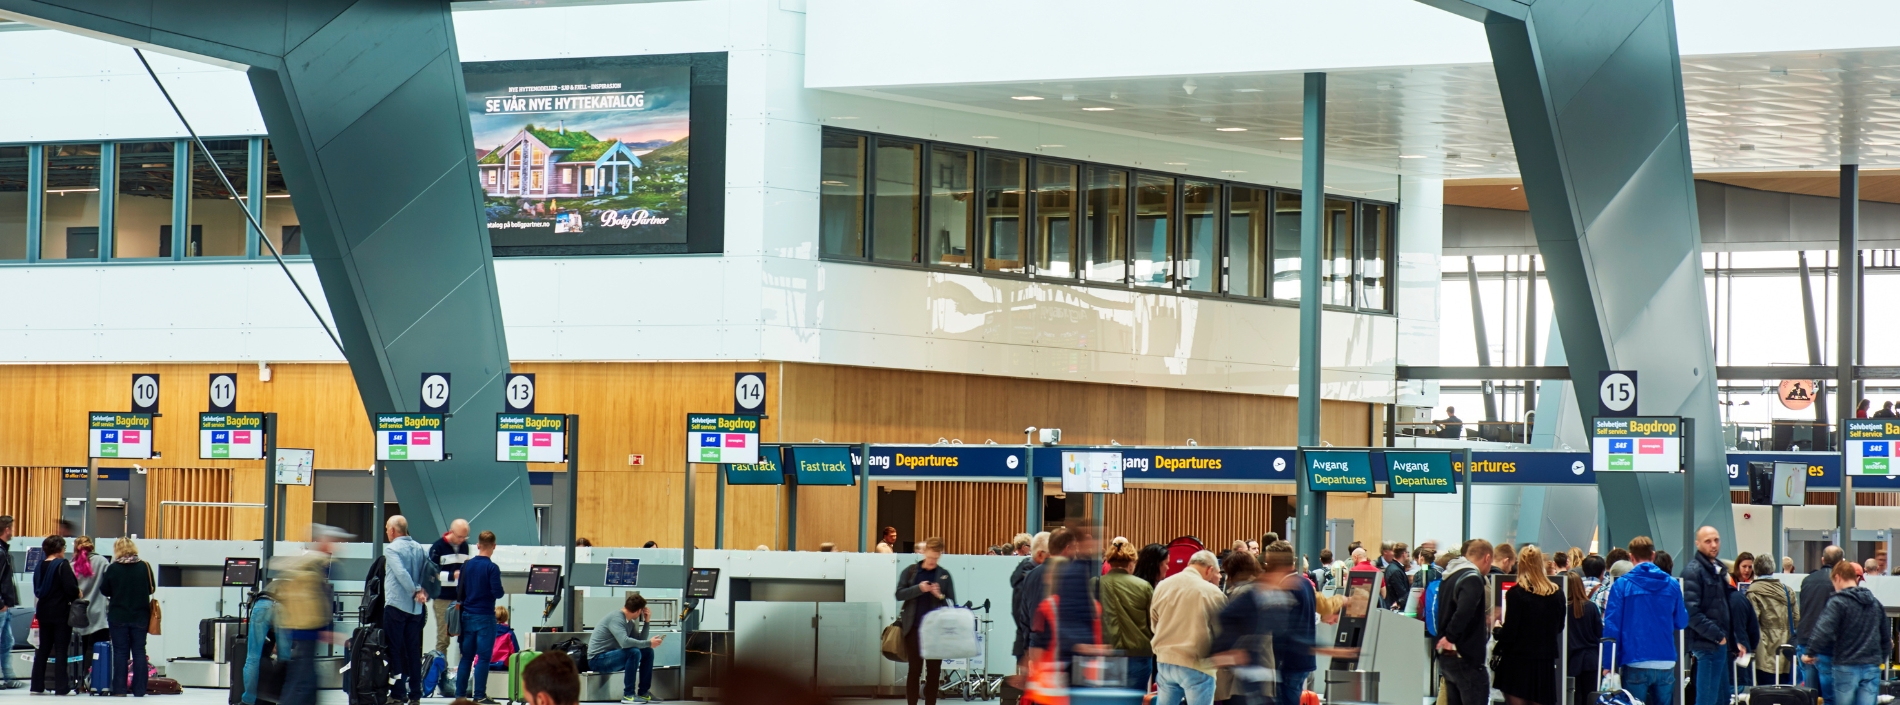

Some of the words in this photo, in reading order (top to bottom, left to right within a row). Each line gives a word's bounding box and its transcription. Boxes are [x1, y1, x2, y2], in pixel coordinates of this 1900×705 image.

[486, 100, 500, 112] SE
[503, 95, 526, 111] VÅR
[529, 98, 552, 110] NYE
[554, 95, 644, 109] HYTTEKATALOG
[137, 384, 154, 399] 10
[214, 384, 230, 399] 11
[427, 383, 444, 399] 12
[511, 384, 529, 400] 13
[741, 383, 760, 400] 14
[1607, 383, 1630, 401] 15
[116, 415, 149, 428] Bagdrop
[226, 415, 260, 428] Bagdrop
[404, 416, 440, 428] Bagdrop
[526, 417, 561, 430] Bagdrop
[718, 417, 756, 431] Bagdrop
[1630, 420, 1676, 435] Bagdrop
[1850, 423, 1883, 431] Selvbetjent
[800, 461, 820, 471] Fast
[822, 461, 846, 471] track
[851, 452, 890, 469] Avang
[896, 453, 958, 469] Departures
[1155, 456, 1222, 472] Departures
[1313, 459, 1349, 472] Avgang
[1393, 460, 1430, 472] Avgang
[1314, 474, 1366, 486] Departures
[1395, 475, 1448, 487] Departures
